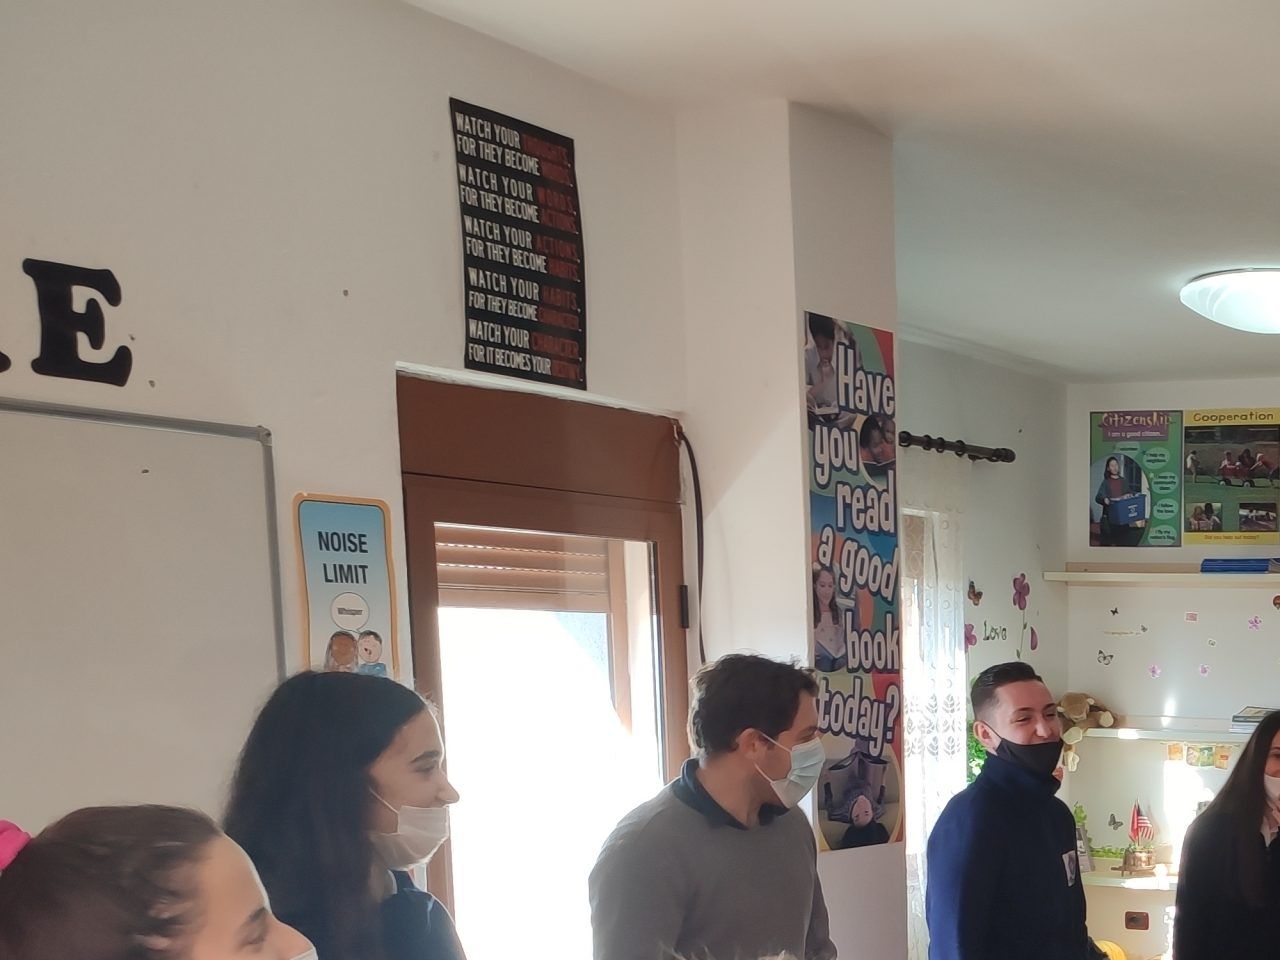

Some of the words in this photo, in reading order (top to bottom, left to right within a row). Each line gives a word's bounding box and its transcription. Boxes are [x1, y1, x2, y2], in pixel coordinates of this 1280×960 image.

[455, 112, 492, 140] WATCH
[494, 124, 521, 149] YOUR
[456, 134, 477, 157] FOR
[479, 141, 502, 164] THEY
[505, 148, 540, 176] BECOME
[458, 163, 498, 191] WATCH
[501, 176, 533, 201] YOUR
[460, 185, 478, 207] FOR
[480, 191, 503, 213] THEY
[505, 198, 540, 223] BECOME
[464, 215, 501, 241] WATCH
[502, 225, 533, 250] YOUR
[465, 237, 485, 259] FOR
[486, 242, 511, 264] THEY
[512, 248, 547, 273] BECOME
[467, 267, 507, 293] WATCH
[510, 277, 540, 301] YOUR
[0, 258, 132, 387] E
[468, 291, 485, 310] FOR
[487, 295, 507, 314] THEY
[508, 299, 538, 321] BECOME
[468, 319, 501, 343] WATCH
[503, 325, 530, 349] YOUR
[468, 343, 485, 363] FOR
[486, 347, 494, 364] IT
[494, 348, 531, 371] BECOMES
[531, 355, 552, 376] YOUR
[836, 342, 896, 416] Have
[1102, 411, 1172, 430] Citizenship
[1193, 411, 1274, 423] Cooperation
[814, 423, 858, 487] you
[836, 470, 896, 534] read
[317, 531, 369, 554] NOISE
[323, 563, 369, 585] LIMIT
[818, 525, 835, 568] a
[840, 537, 899, 602] good
[845, 609, 900, 672] book
[817, 676, 900, 757] today?
